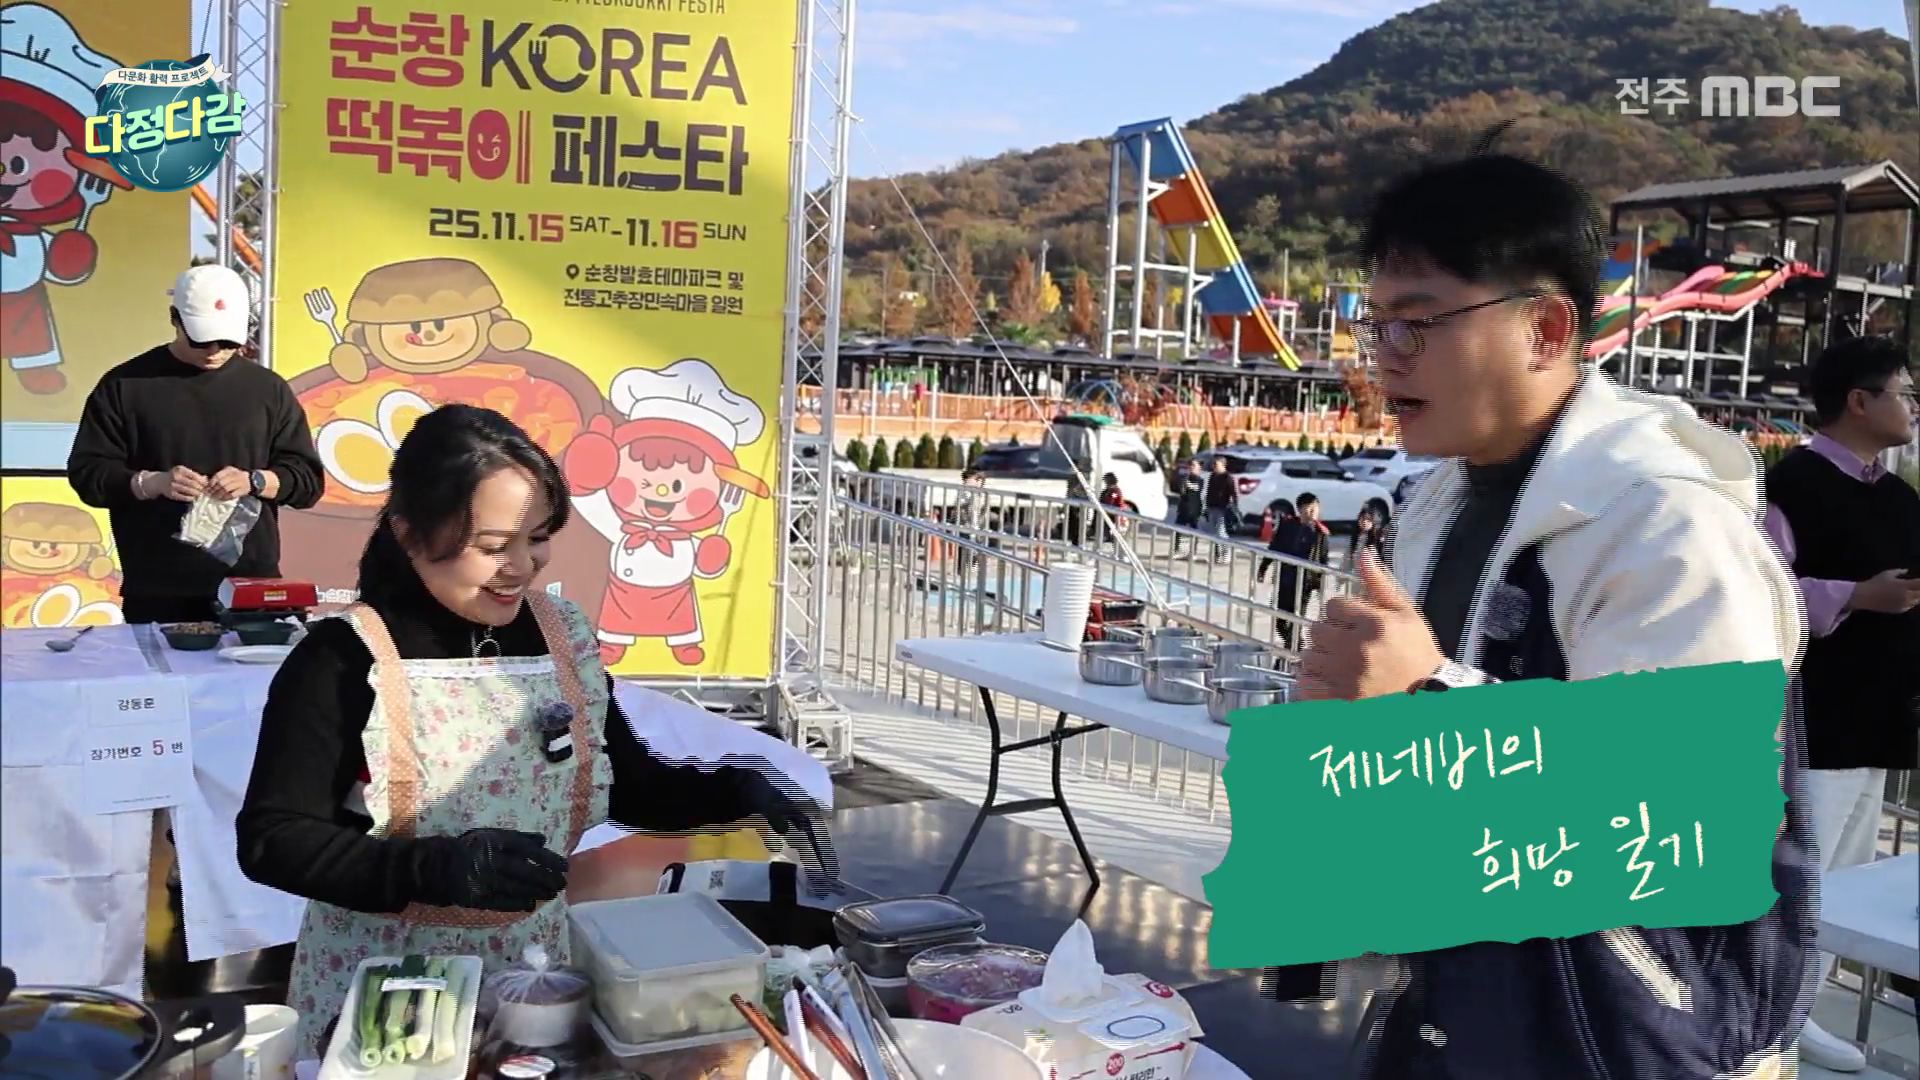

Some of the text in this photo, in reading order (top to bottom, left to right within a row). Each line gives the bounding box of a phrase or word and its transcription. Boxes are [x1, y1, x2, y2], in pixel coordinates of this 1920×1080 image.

[329, 7, 748, 106] 순창 KOREA
[327, 97, 749, 196] 떡볶이 페스타
[703, 222, 747, 241] SUN
[585, 264, 744, 291] 순창발효테마파크 및
[564, 287, 744, 315] 전통고추장민속마을 일원
[152, 739, 165, 756] 5
